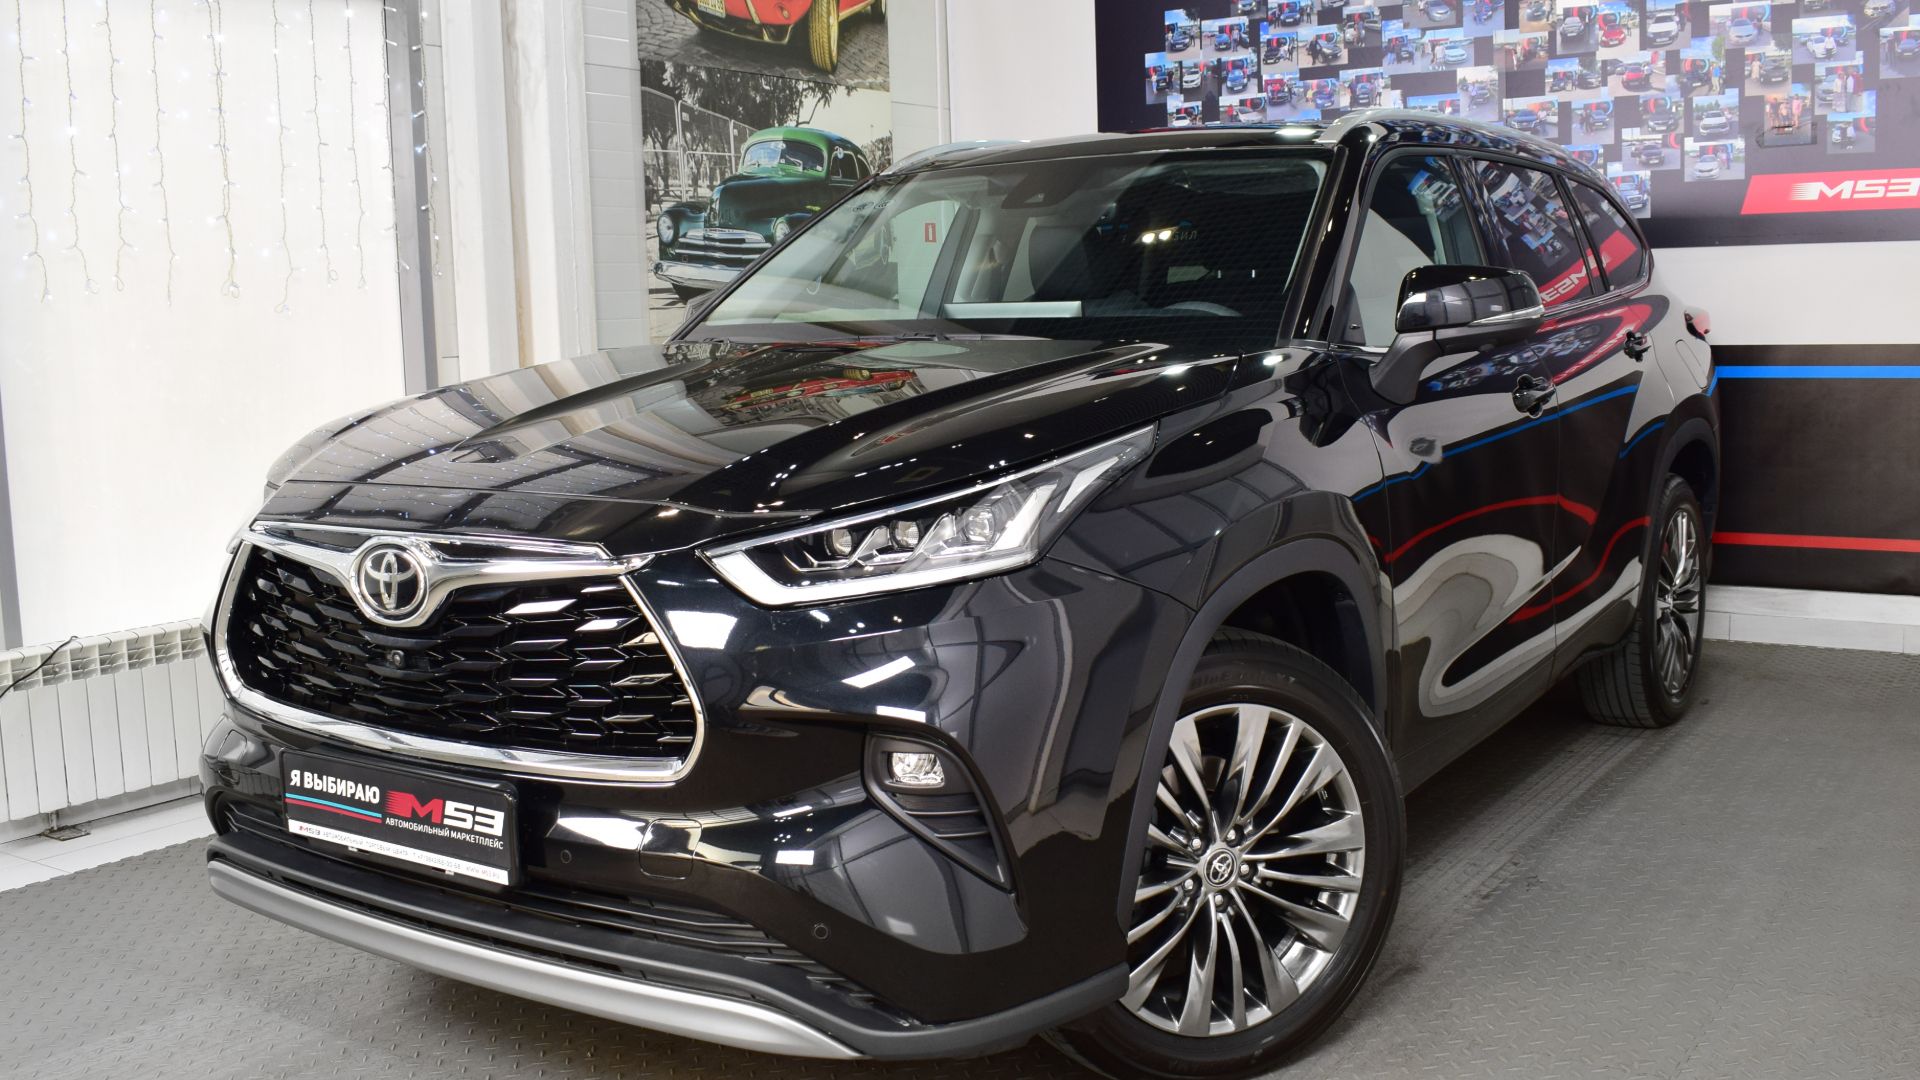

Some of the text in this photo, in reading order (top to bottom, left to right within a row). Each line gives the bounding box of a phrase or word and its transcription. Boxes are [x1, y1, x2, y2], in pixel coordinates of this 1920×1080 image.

[289, 770, 380, 804] Я ВЫБИРАЮ
[385, 817, 504, 850] АВТОМОБИЛЬНЫЙ МАРКЕТПЛЕЙС
